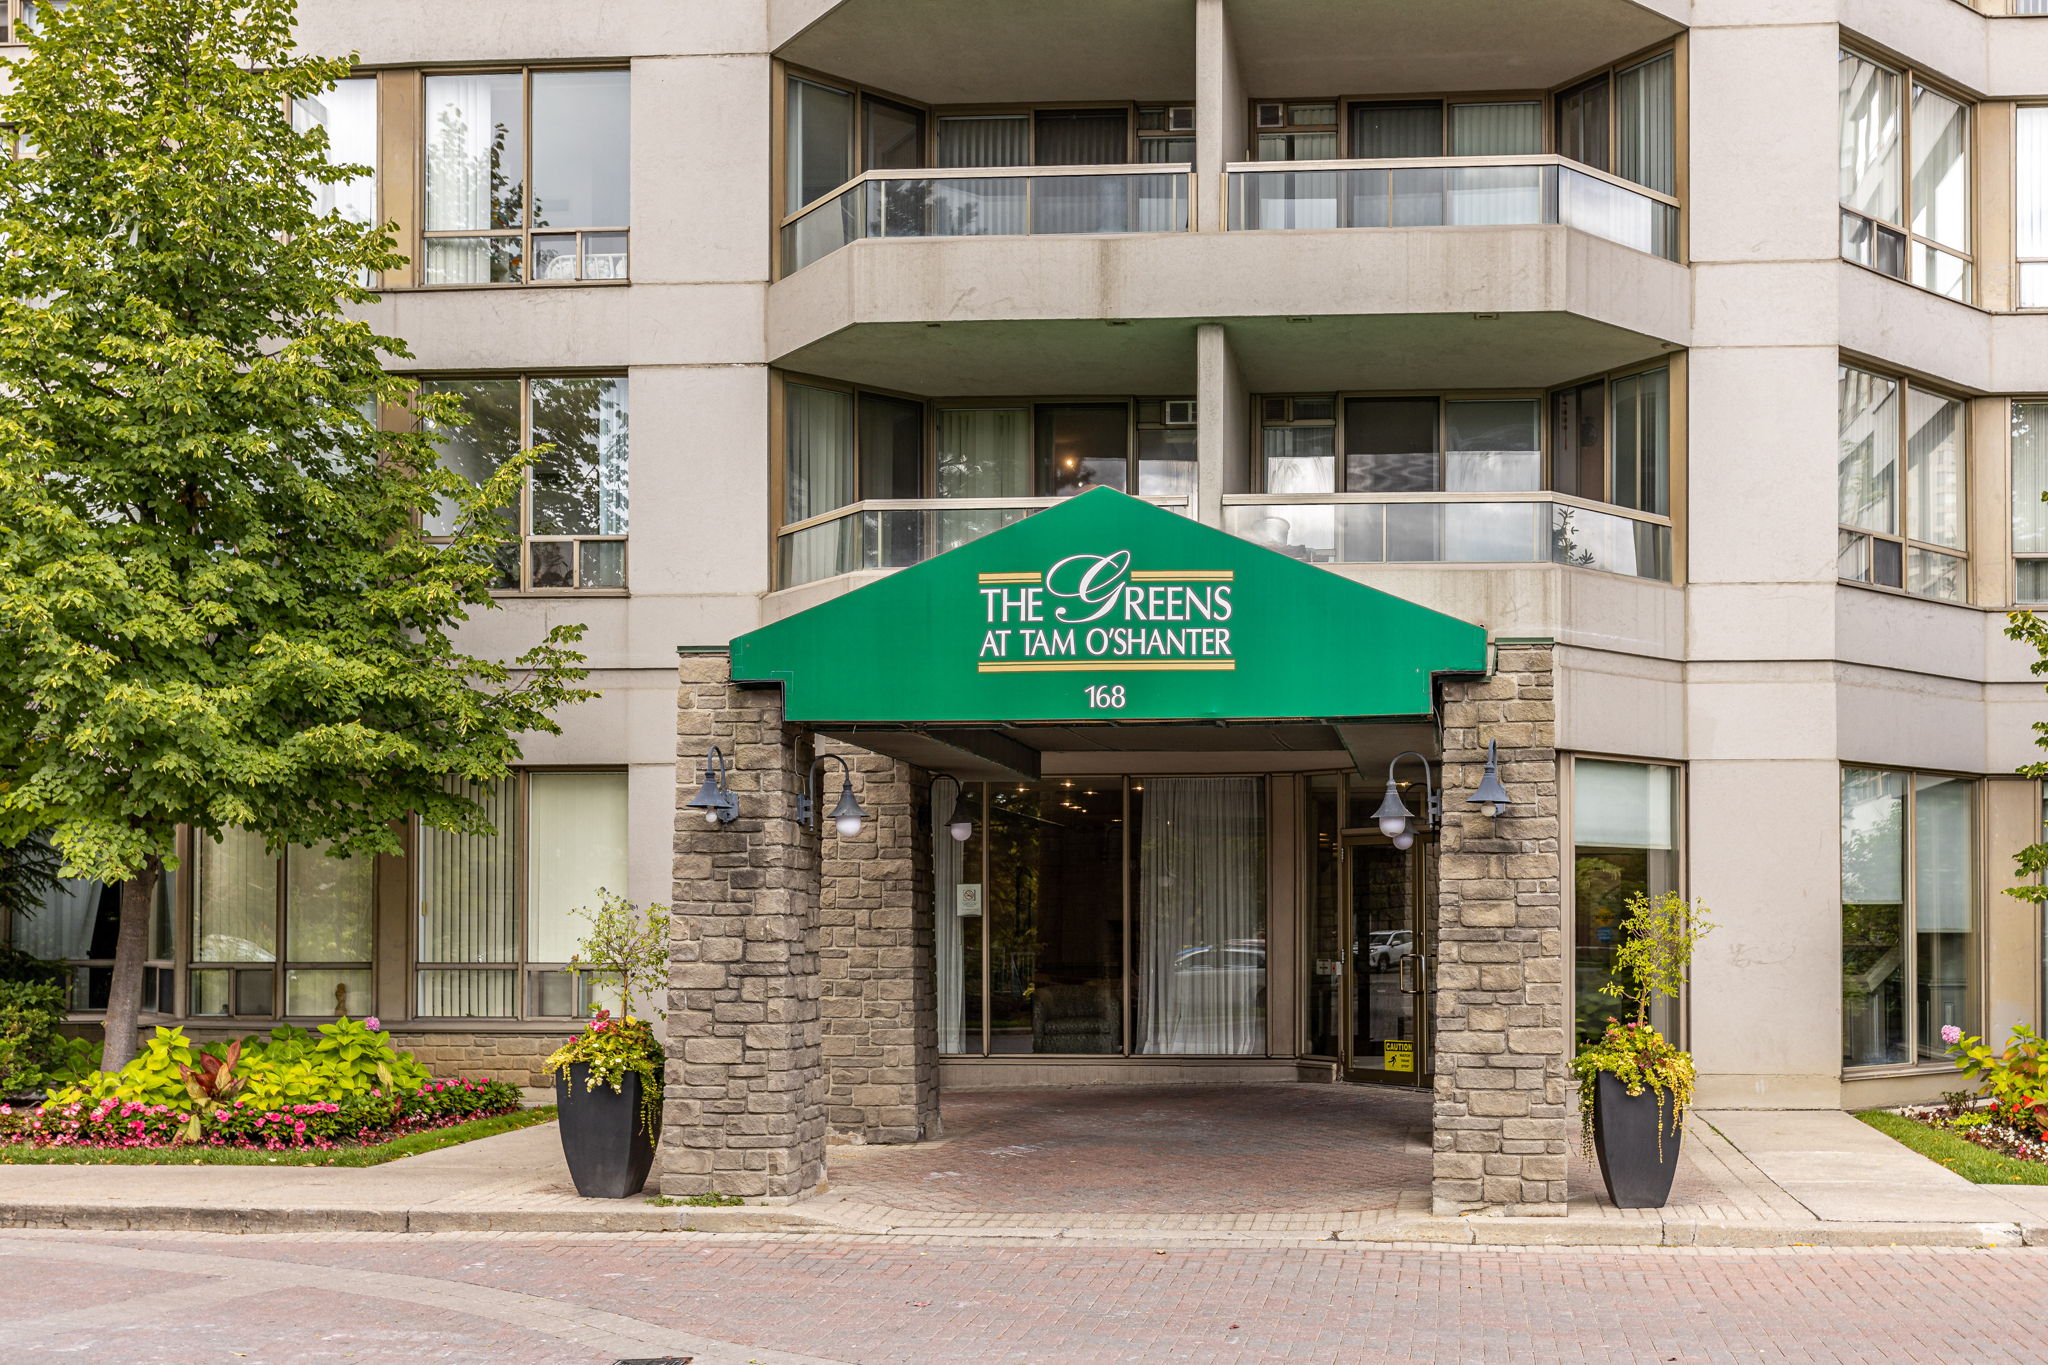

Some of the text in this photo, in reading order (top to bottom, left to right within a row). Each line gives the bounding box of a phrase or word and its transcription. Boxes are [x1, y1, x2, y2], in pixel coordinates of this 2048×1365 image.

[979, 549, 1233, 623] THE GREENS
[979, 627, 1232, 657] AT TAM O'SHANTER
[1084, 685, 1126, 708] 168
[1386, 1042, 1413, 1051] CAUTION
